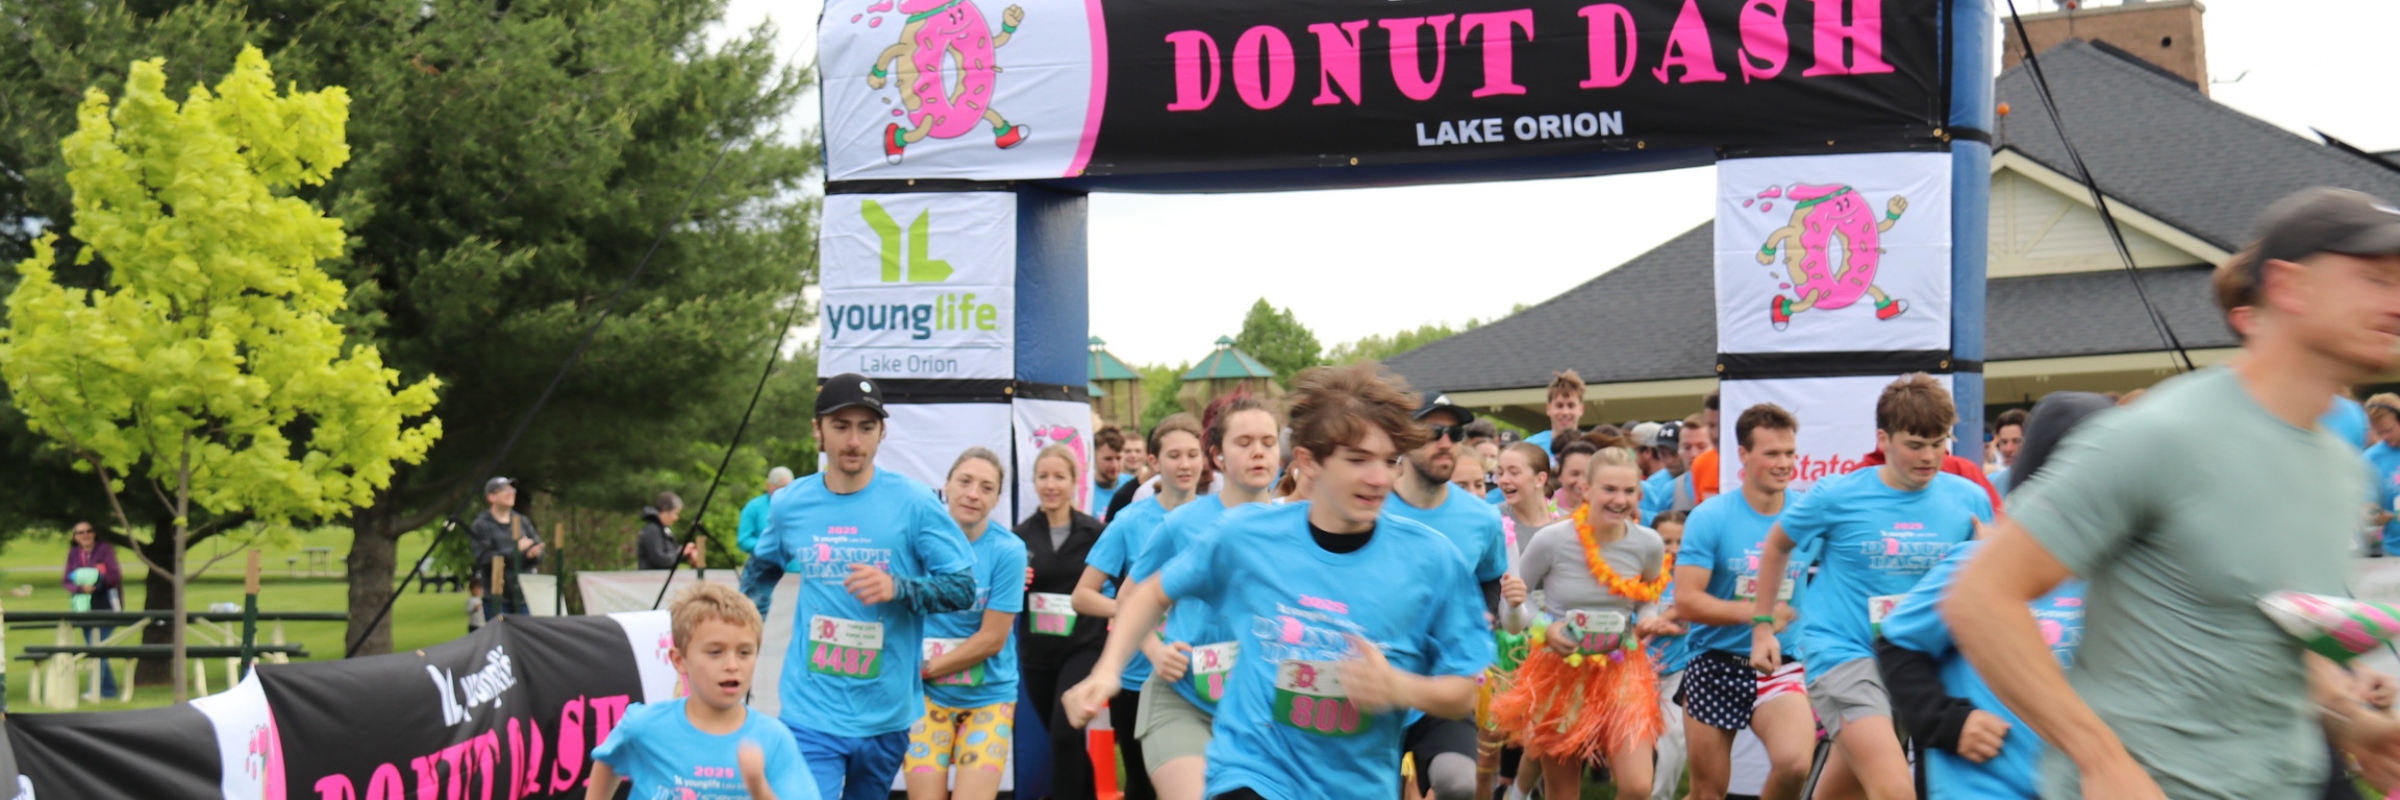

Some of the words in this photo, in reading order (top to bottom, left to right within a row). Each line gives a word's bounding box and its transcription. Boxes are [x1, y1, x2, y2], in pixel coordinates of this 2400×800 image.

[1165, 8, 1534, 111] DONUT
[1577, 0, 1895, 88] DASH
[1416, 118, 1504, 146] LAKE
[1514, 111, 1624, 141] ORION
[861, 199, 954, 282] YL
[826, 293, 998, 340] younglife
[860, 355, 902, 373] Lake
[907, 355, 957, 373] Orion
[811, 642, 877, 675] 4487
[693, 765, 735, 779] 2025
